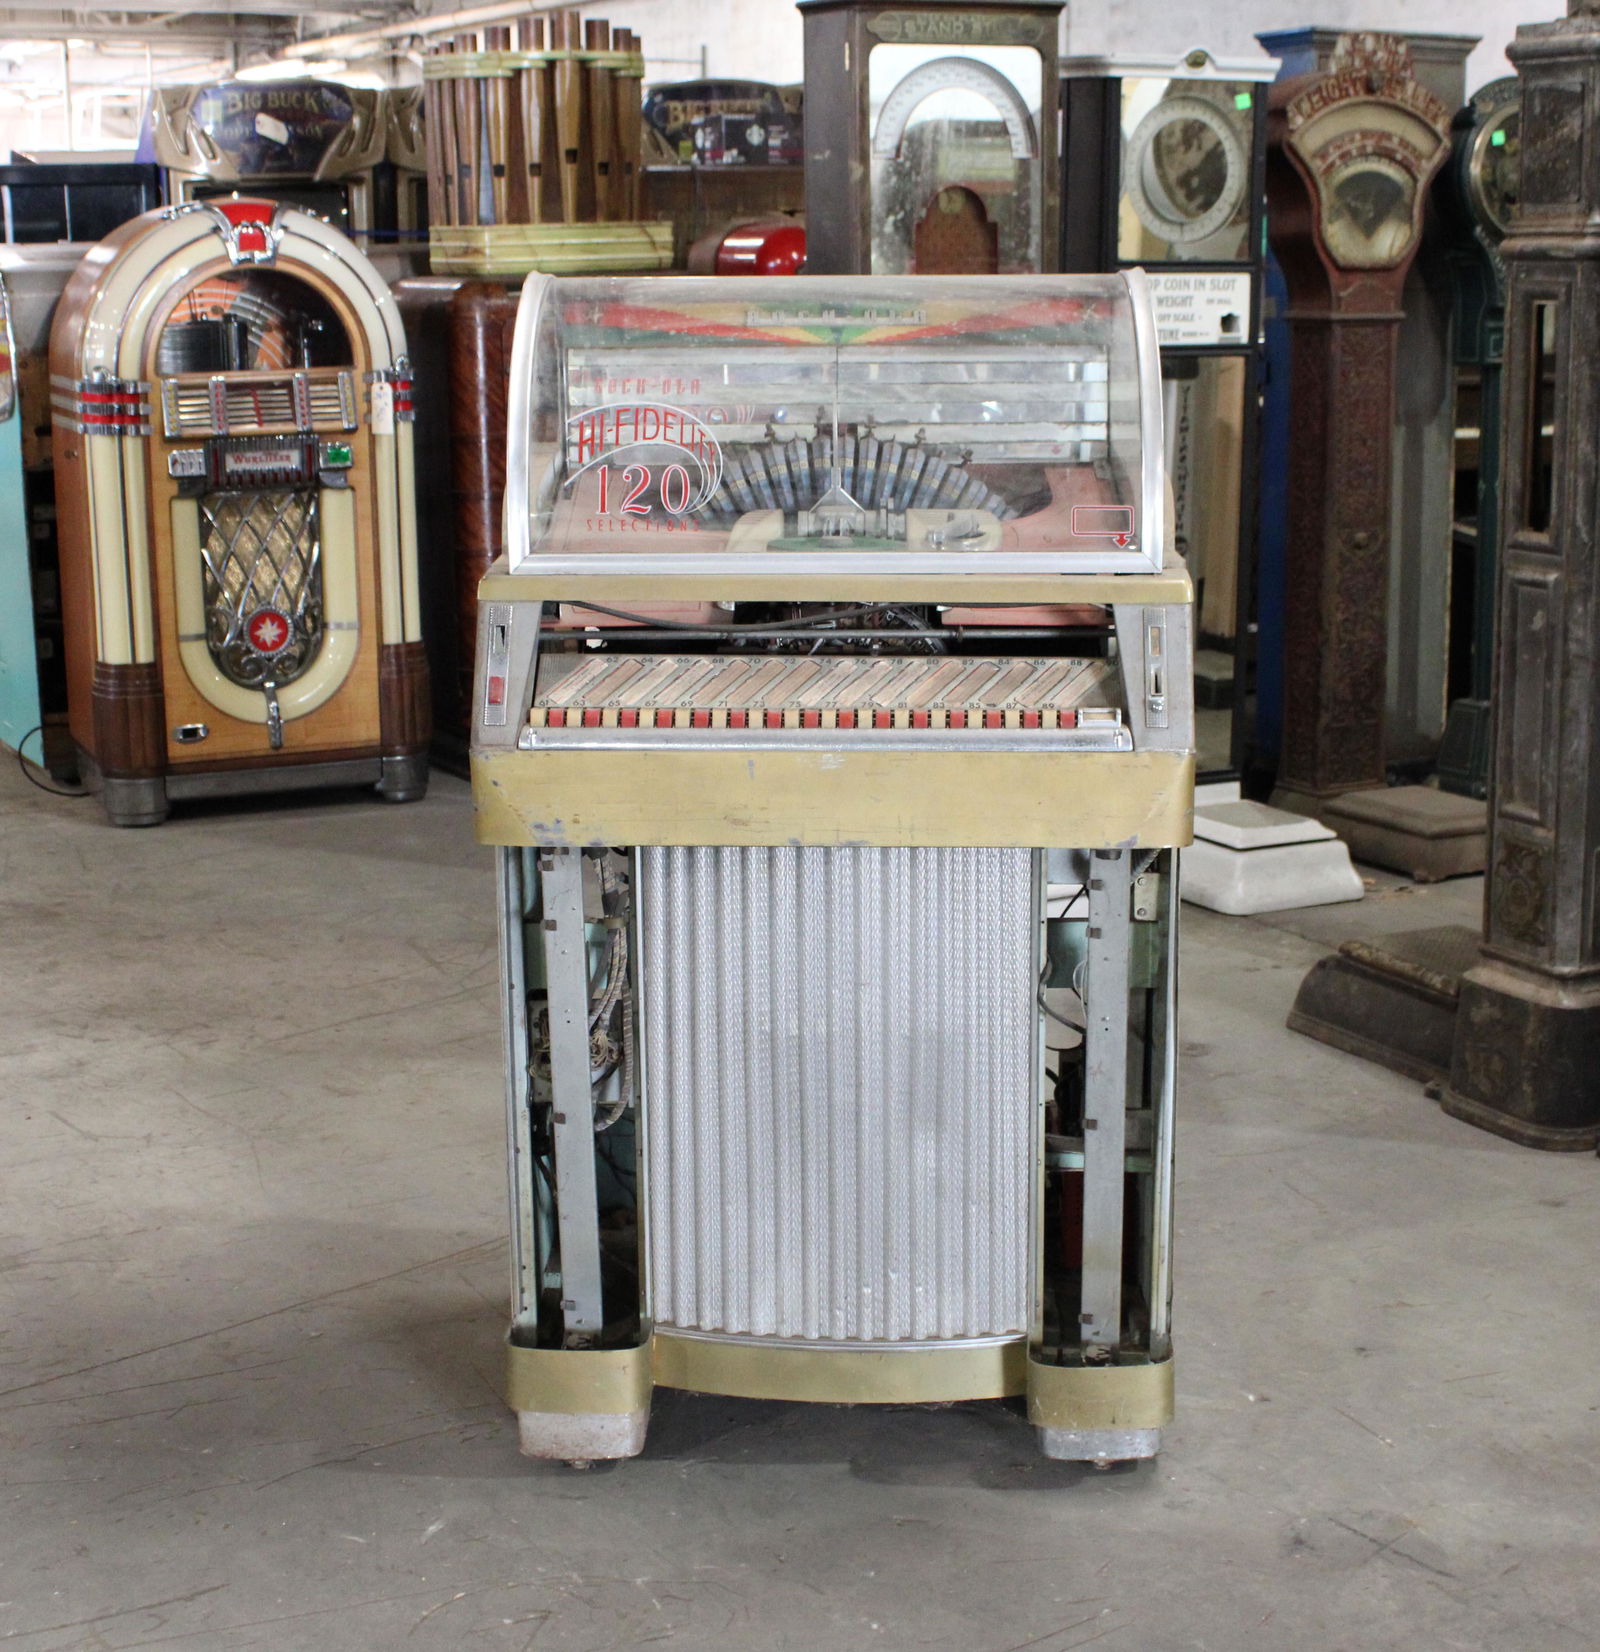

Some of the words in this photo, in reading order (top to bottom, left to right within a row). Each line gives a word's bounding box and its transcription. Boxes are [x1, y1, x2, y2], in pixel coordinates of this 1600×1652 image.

[227, 90, 262, 113] BIG
[268, 90, 320, 113] BUCK
[1147, 278, 1160, 291] OP
[1164, 278, 1190, 291] COIN
[1194, 278, 1206, 291] IN
[1210, 278, 1237, 291] SLOT
[1156, 295, 1194, 308] WEIGHT
[1173, 312, 1195, 322] SCALE
[1158, 328, 1180, 341] TUNE
[578, 407, 716, 473] HI-FIDELITY
[596, 464, 690, 515] 120
[586, 518, 701, 532] SELECTIONS
